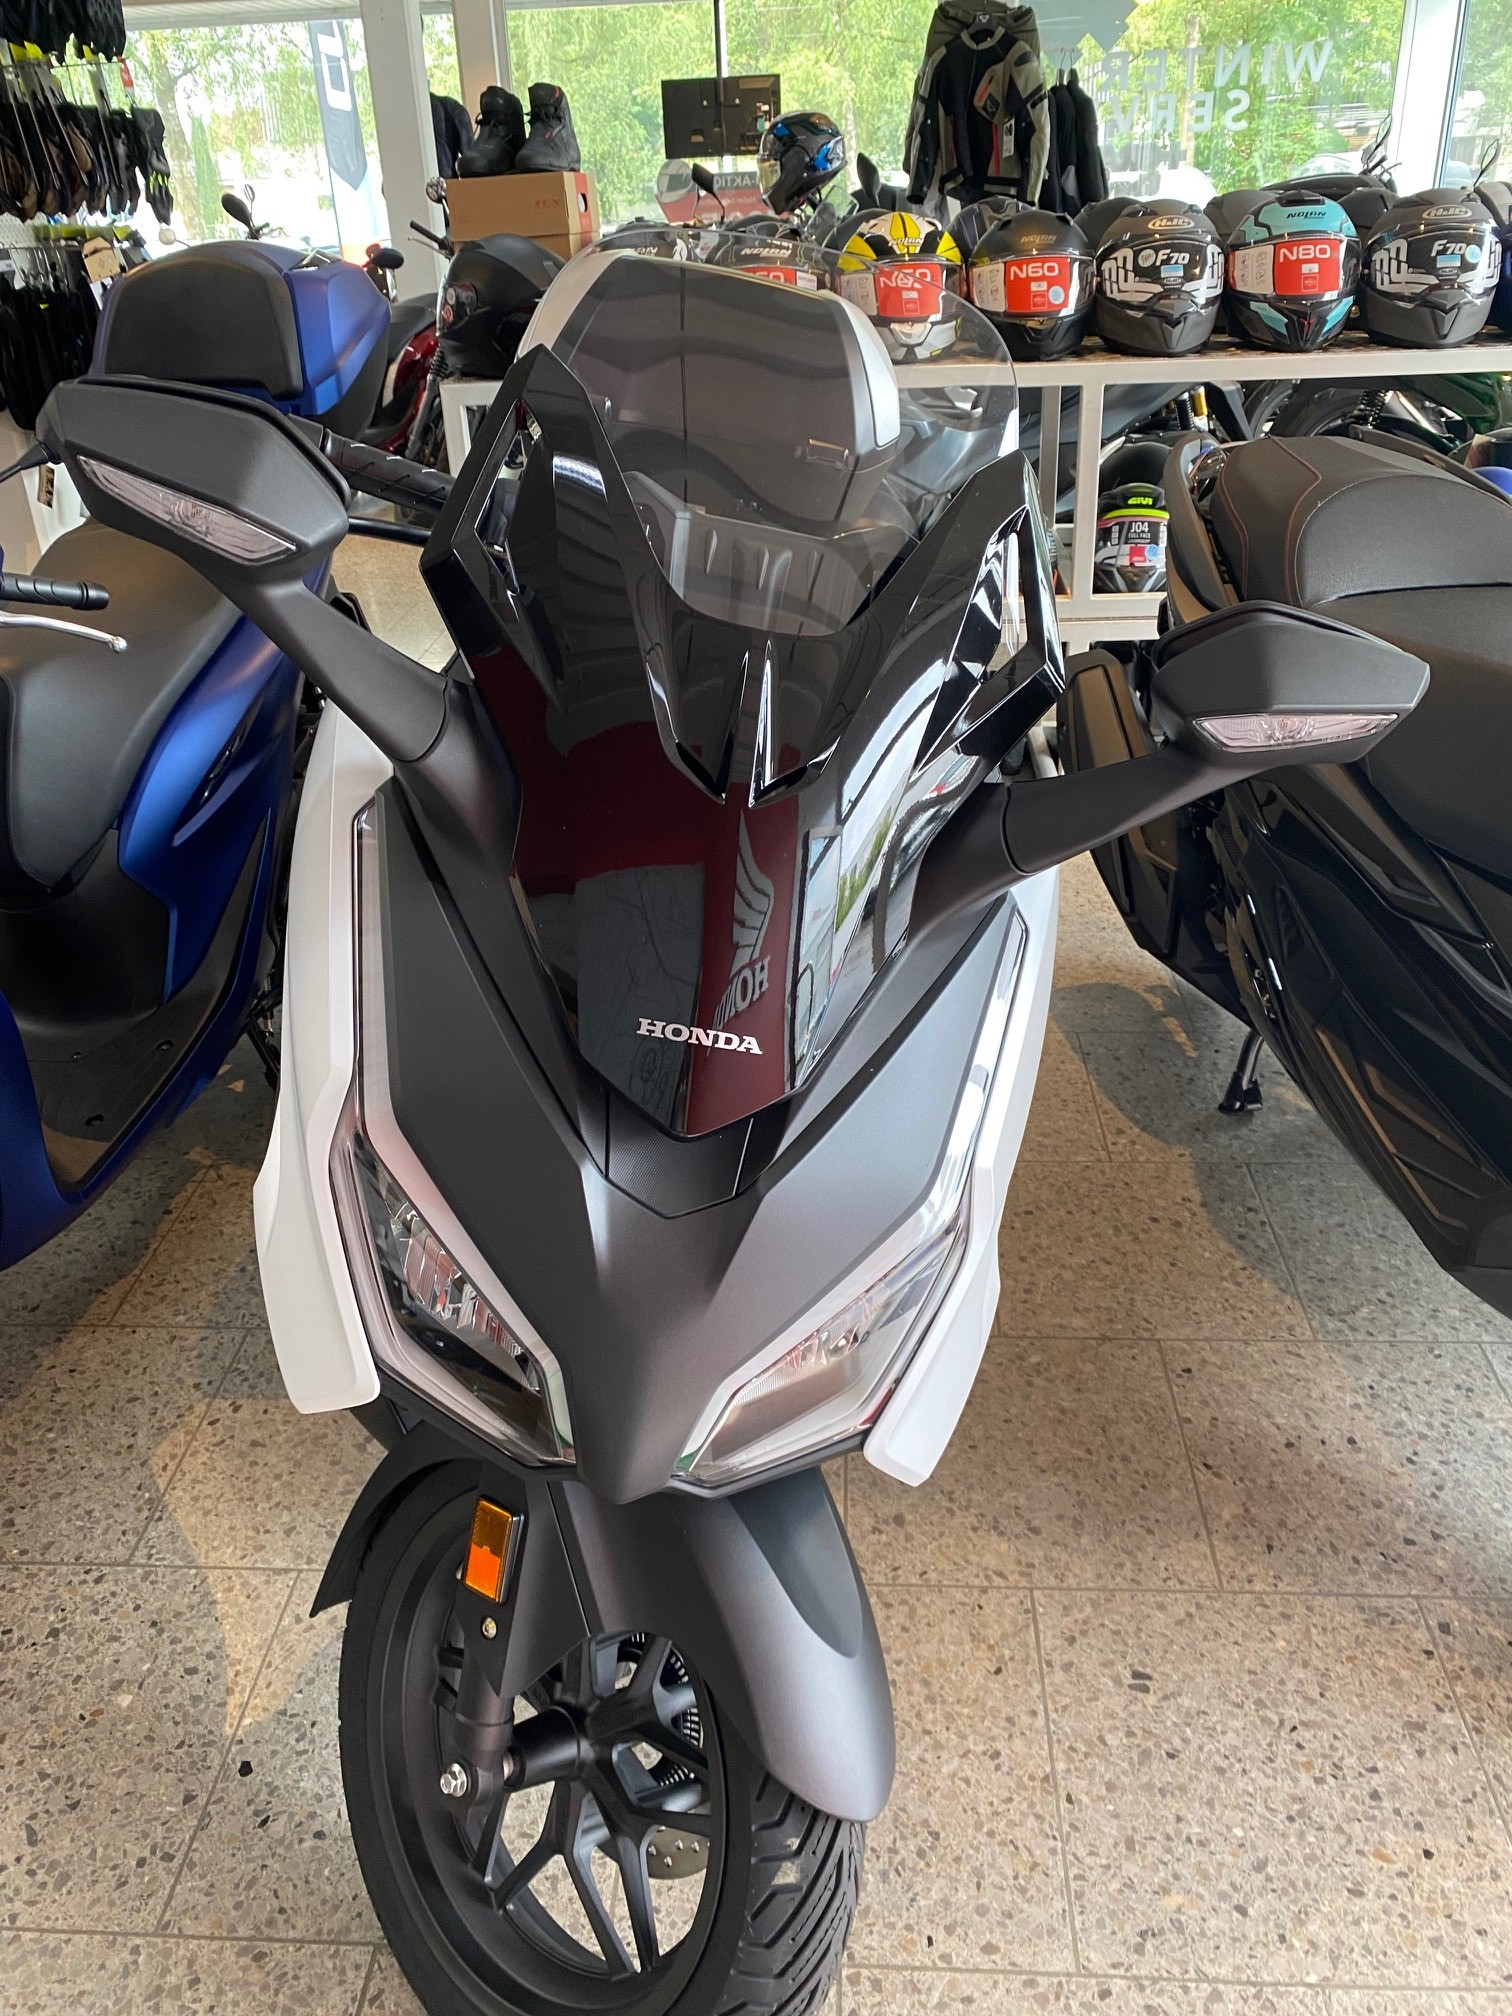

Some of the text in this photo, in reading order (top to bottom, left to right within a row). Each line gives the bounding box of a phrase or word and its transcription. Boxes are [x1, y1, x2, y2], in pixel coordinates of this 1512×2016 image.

[1286, 211, 1327, 220] NOLAN
[1430, 208, 1468, 217] HJC
[1280, 244, 1331, 263] N80
[1431, 239, 1467, 257] F70
[1156, 249, 1190, 266] F70
[1010, 261, 1059, 280] N60
[1127, 496, 1153, 505] GIVI
[1130, 522, 1149, 533] J04
[636, 1018, 763, 1055] HONDA
